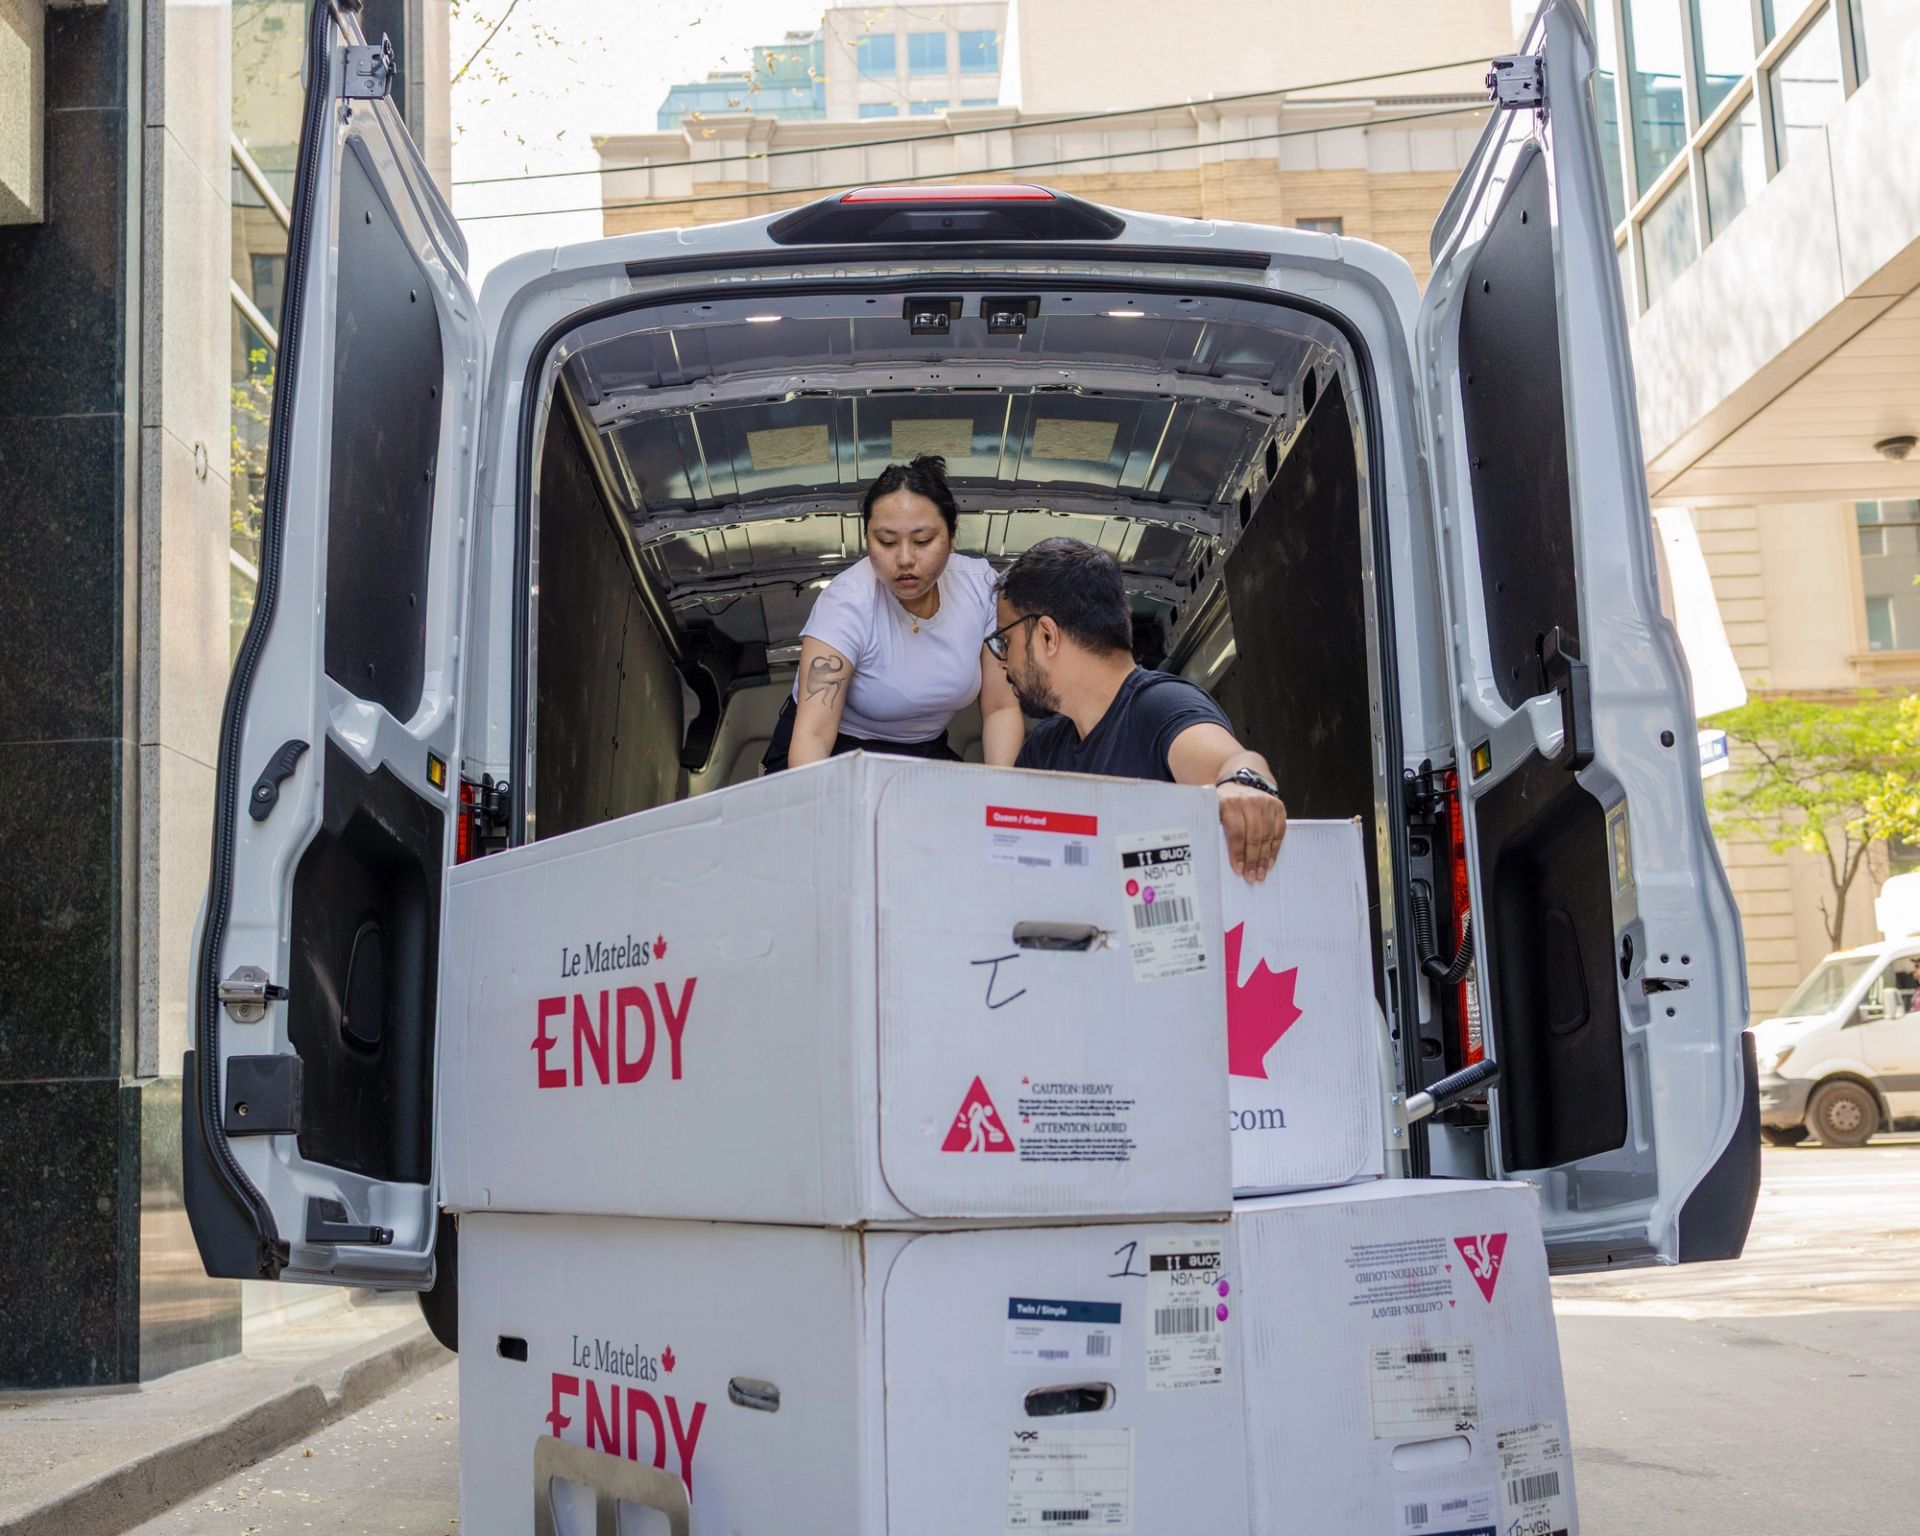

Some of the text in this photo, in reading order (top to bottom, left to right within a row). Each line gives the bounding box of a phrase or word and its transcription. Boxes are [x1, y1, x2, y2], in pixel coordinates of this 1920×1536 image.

[993, 812, 1018, 823] Queen
[1023, 815, 1047, 826] Grand
[1137, 846, 1191, 865] Zone 11
[1144, 863, 1191, 880] LD-VGN
[561, 935, 650, 978] Le Matelas
[530, 977, 698, 1089] ENDY
[1166, 1254, 1220, 1269] Zone 11
[1171, 1271, 1218, 1287] LD-VGN
[1016, 1304, 1036, 1314] Twin
[1041, 1305, 1068, 1317] Simple
[572, 1335, 658, 1382] Le Matelas
[545, 1372, 708, 1505] ENDY
